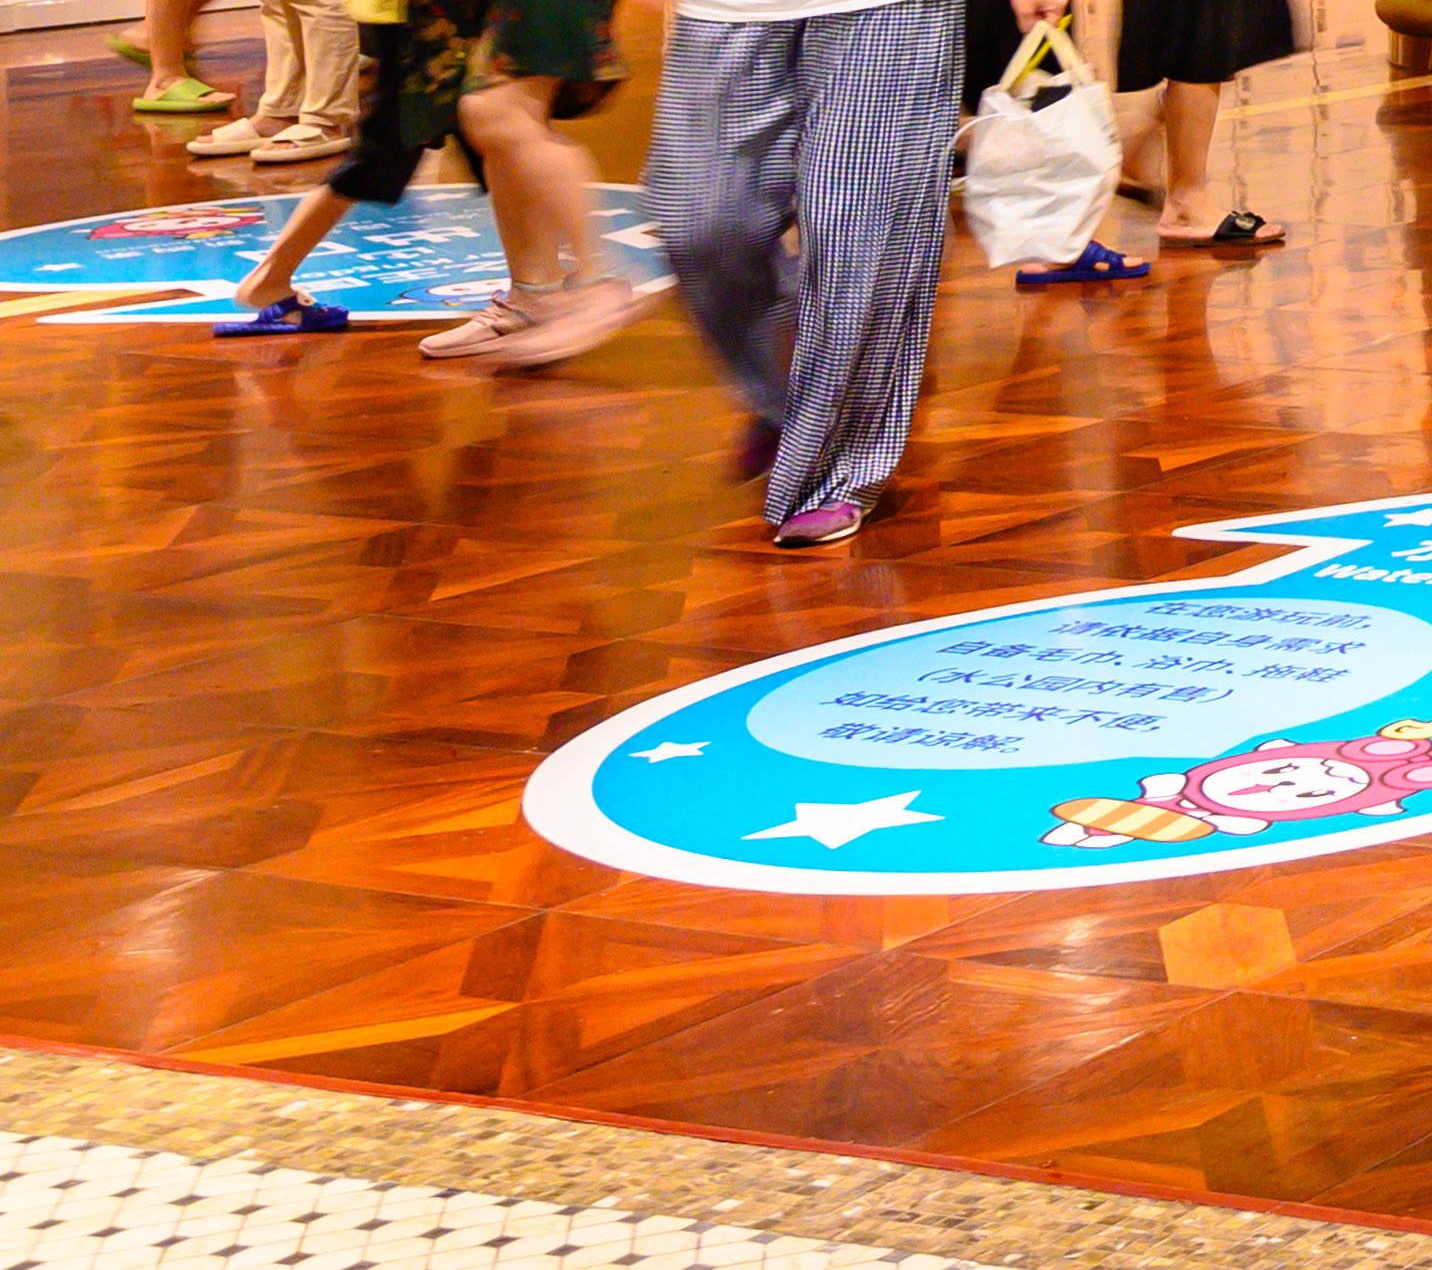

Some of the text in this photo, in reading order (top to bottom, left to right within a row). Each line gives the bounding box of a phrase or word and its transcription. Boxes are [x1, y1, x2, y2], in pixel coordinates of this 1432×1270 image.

[1051, 619, 1368, 656] 请依据自身需求
[937, 639, 1351, 684] 自备毛巾、浴巾、拖鞋
